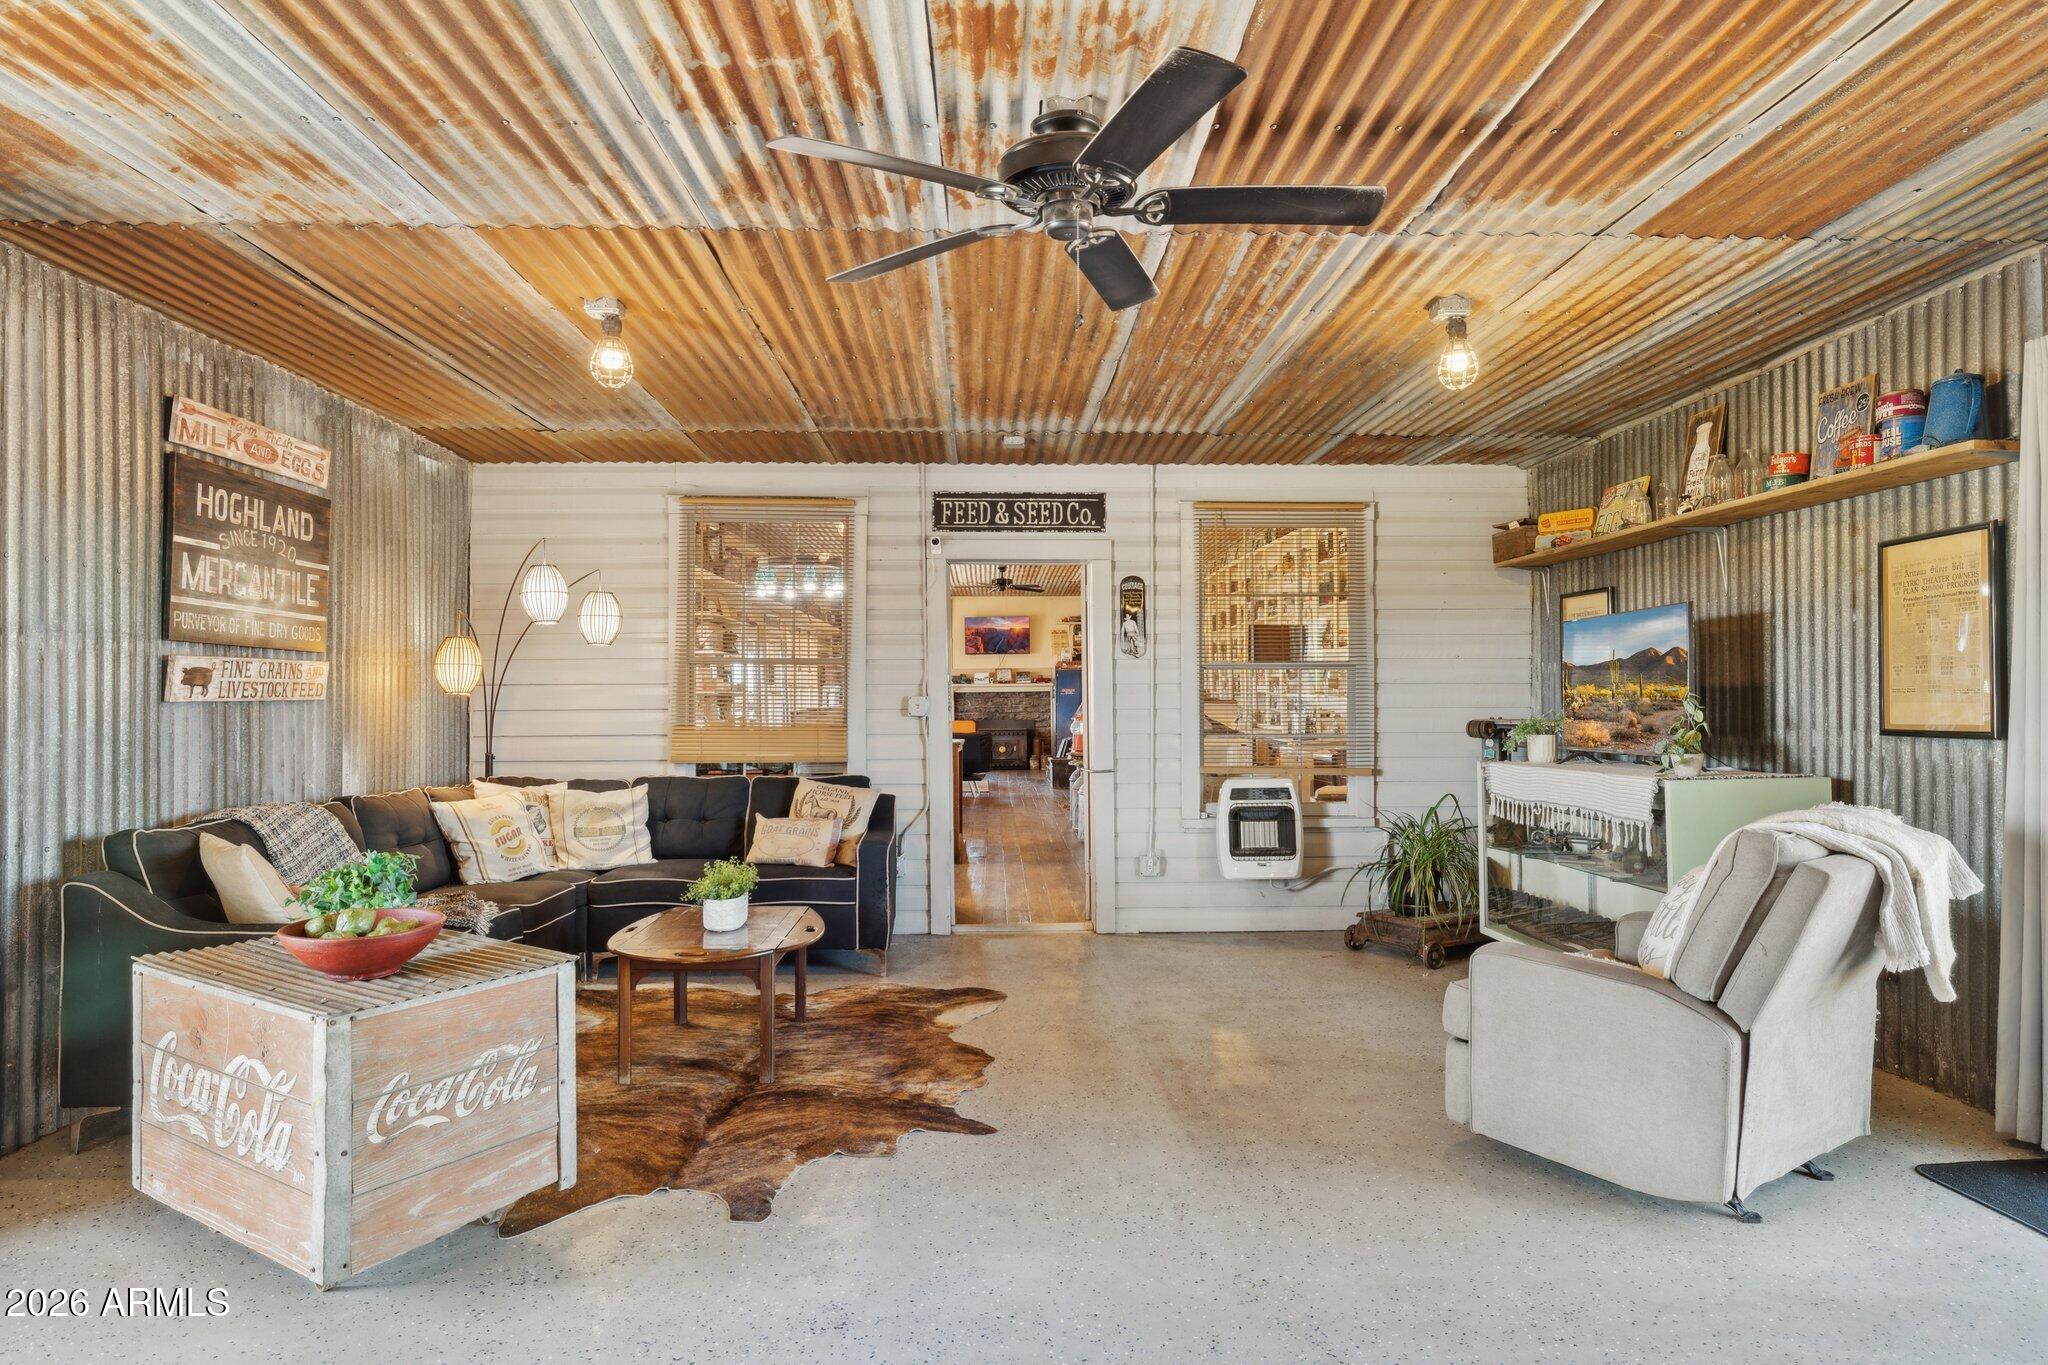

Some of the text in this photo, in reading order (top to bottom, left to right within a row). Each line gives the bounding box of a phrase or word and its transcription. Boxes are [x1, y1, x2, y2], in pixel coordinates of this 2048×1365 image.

[228, 417, 294, 449] Farm Fresh
[1817, 408, 1858, 444] Coffee
[178, 417, 325, 485] MILK AND EGGS
[196, 483, 314, 541] HOGHLAND
[940, 501, 1096, 526] FEED & SEED Co.
[219, 530, 297, 562] SINCE 1920
[181, 551, 320, 608] MERCANTILE
[1922, 575, 1950, 585] THEATER
[1952, 571, 1980, 581] OWNERS
[1946, 579, 1980, 589] PROGRAM
[173, 611, 322, 642] PURVEYOR OF FINE DRY GOODS
[221, 660, 253, 678] FINE
[258, 663, 303, 679] GRAINS
[217, 681, 324, 699] LIVESTOCK FEED
[816, 784, 850, 796] ORGANIC
[495, 826, 522, 848] SUGAR
[785, 826, 821, 837] GRAINS
[150, 1030, 298, 1172] Coca-Cola
[366, 1034, 546, 1145] Coca-Cola
